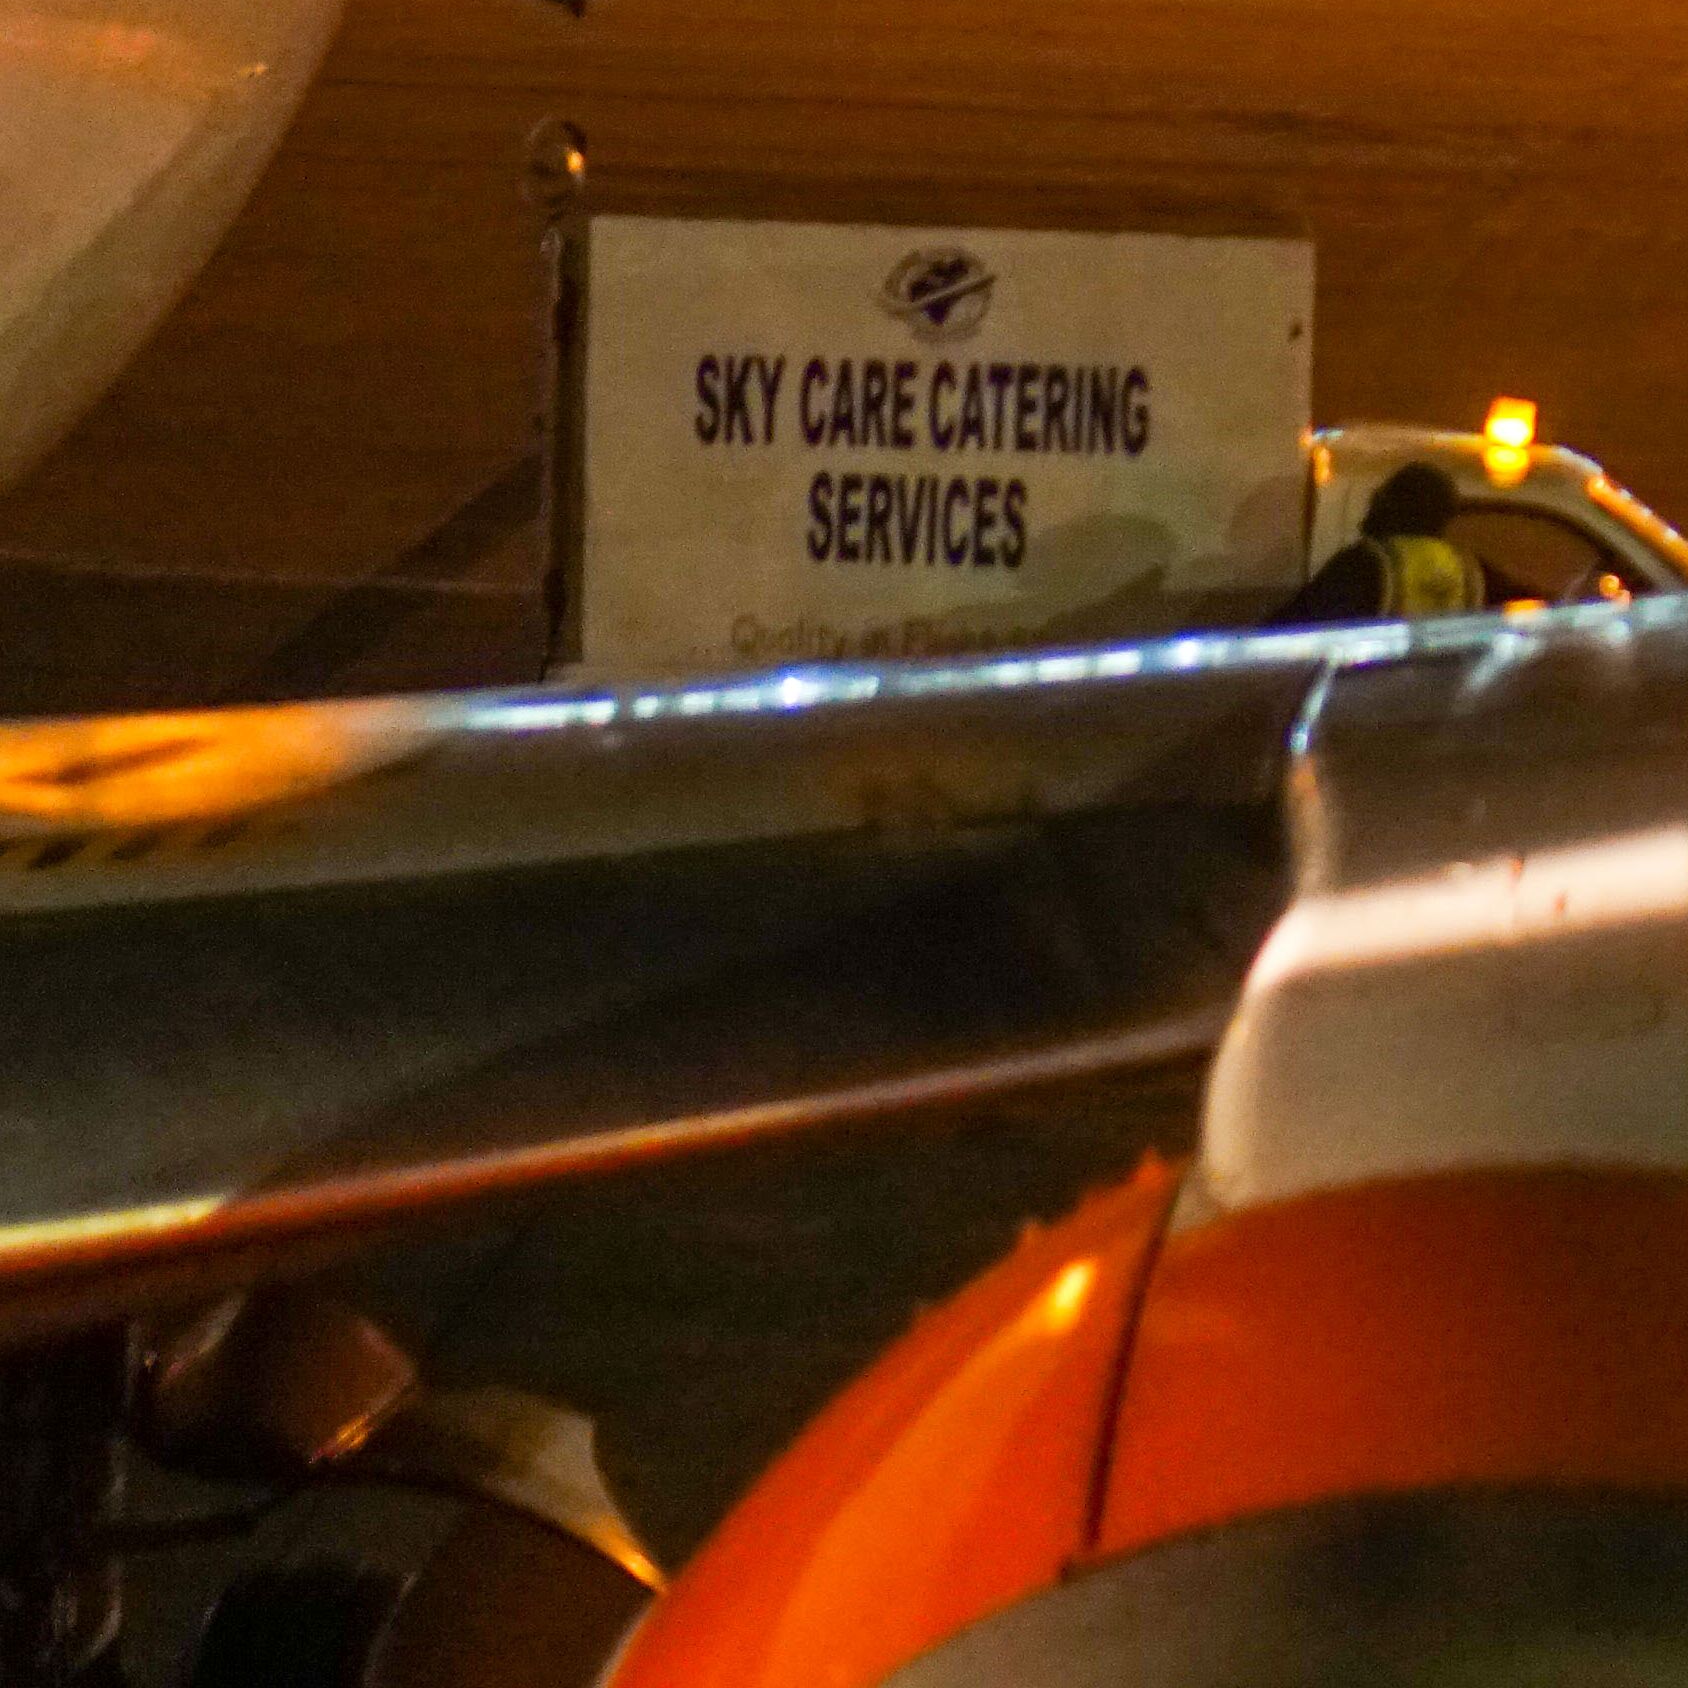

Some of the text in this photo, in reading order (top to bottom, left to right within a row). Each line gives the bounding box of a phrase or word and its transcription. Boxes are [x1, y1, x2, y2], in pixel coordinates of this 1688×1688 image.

[695, 354, 1153, 457] SKY CARE CATERING
[807, 470, 1028, 568] SERVICES
